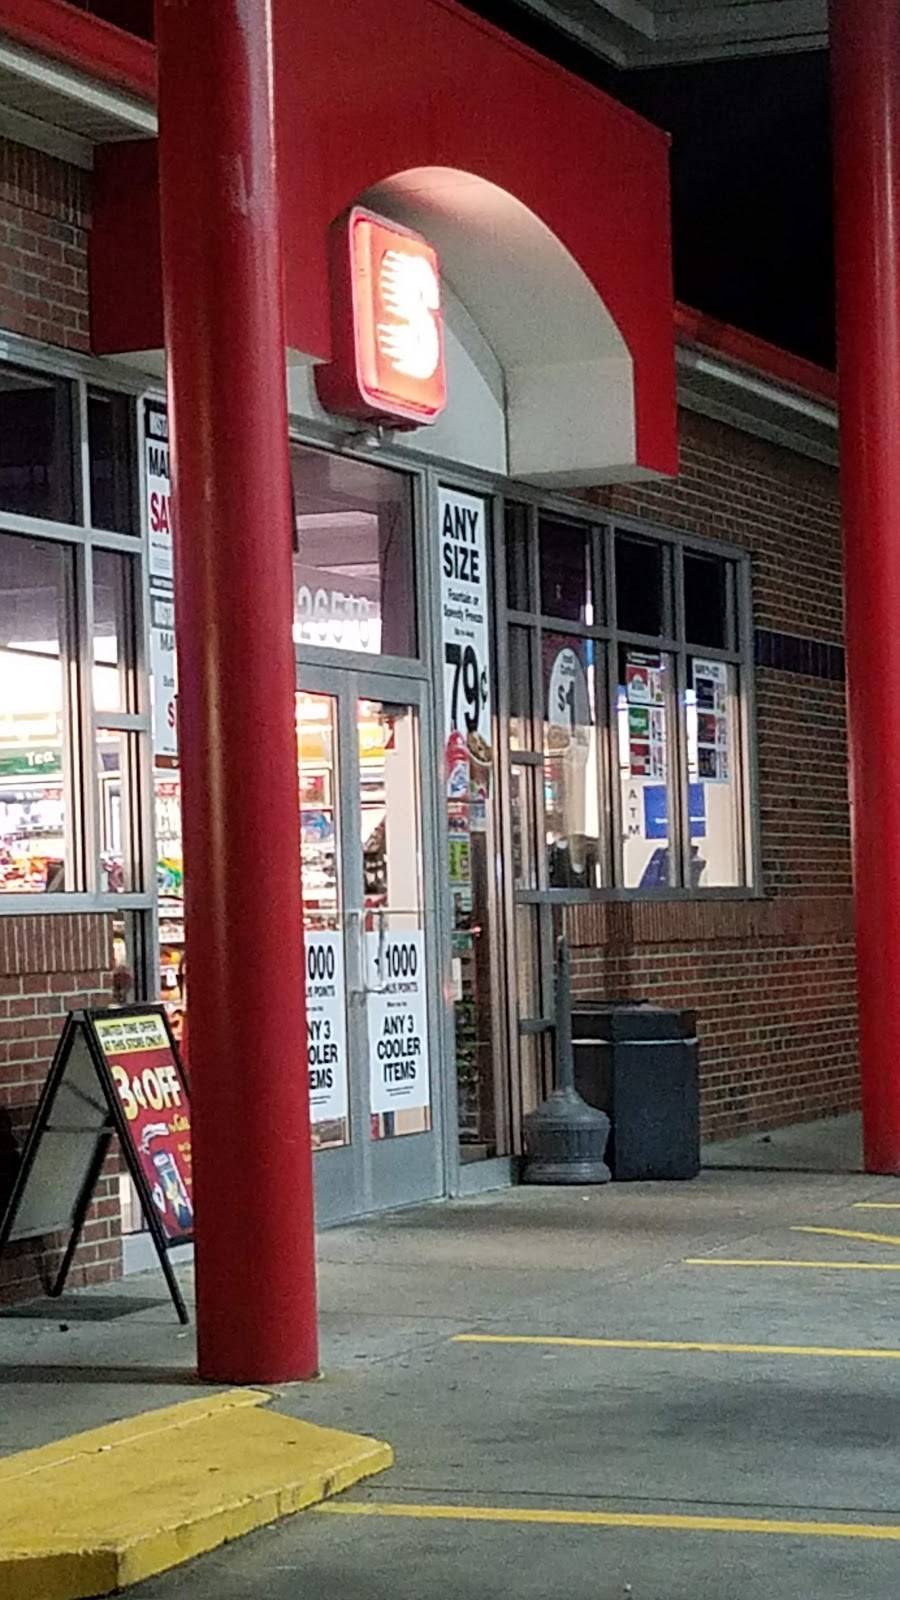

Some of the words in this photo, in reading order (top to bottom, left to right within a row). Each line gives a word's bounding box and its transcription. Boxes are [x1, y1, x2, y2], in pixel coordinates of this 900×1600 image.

[442, 502, 479, 544] ANY
[443, 543, 481, 584] SIZE
[26, 750, 55, 766] Tea
[398, 981, 418, 993] POINTS
[324, 1020, 331, 1038] 3
[383, 1016, 405, 1035] ANY
[407, 1014, 414, 1032] 3
[377, 1037, 420, 1060] COOLER
[383, 1061, 416, 1083] ITEMS
[142, 1065, 182, 1110] OFF
